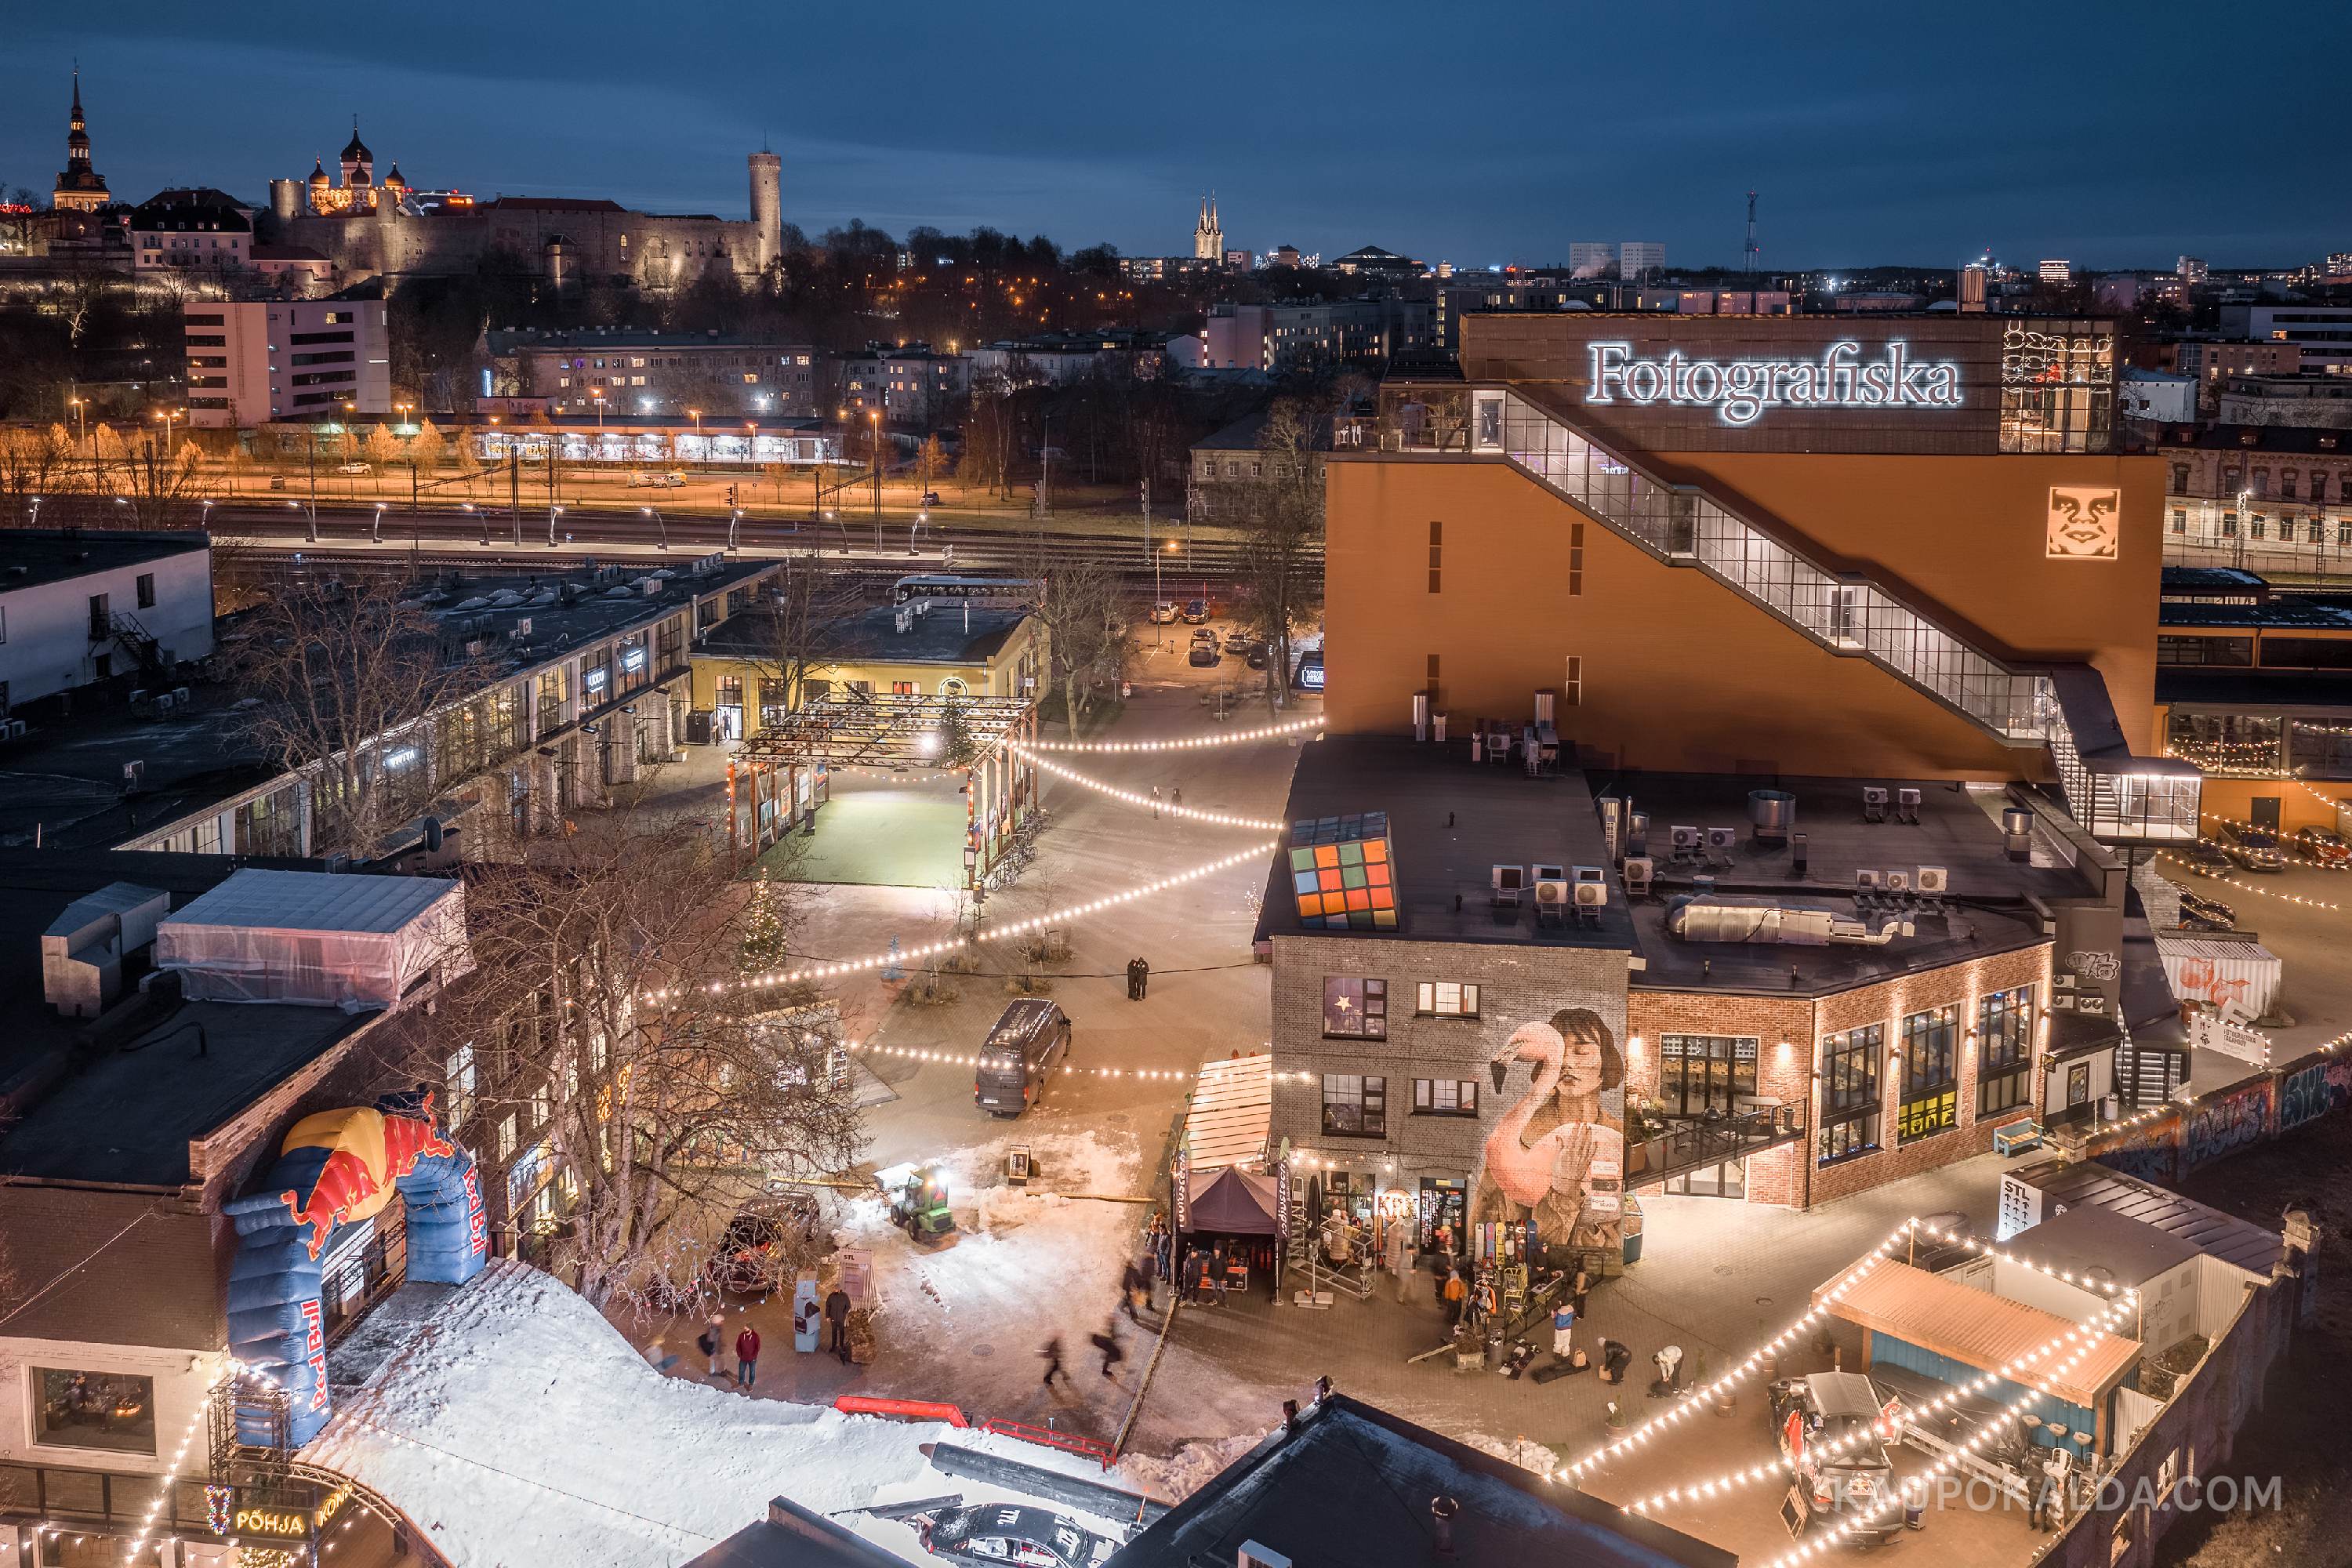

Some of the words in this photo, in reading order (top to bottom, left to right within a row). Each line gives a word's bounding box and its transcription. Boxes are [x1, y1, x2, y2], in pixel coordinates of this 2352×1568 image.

[1588, 340, 1962, 424] Fotografiska
[463, 1165, 481, 1214] Red
[2004, 1181, 2031, 1201] STL
[470, 1210, 488, 1258] Bull
[300, 1298, 324, 1355] Bull
[308, 1352, 328, 1412] Red
[237, 1508, 305, 1535] PÕHJA
